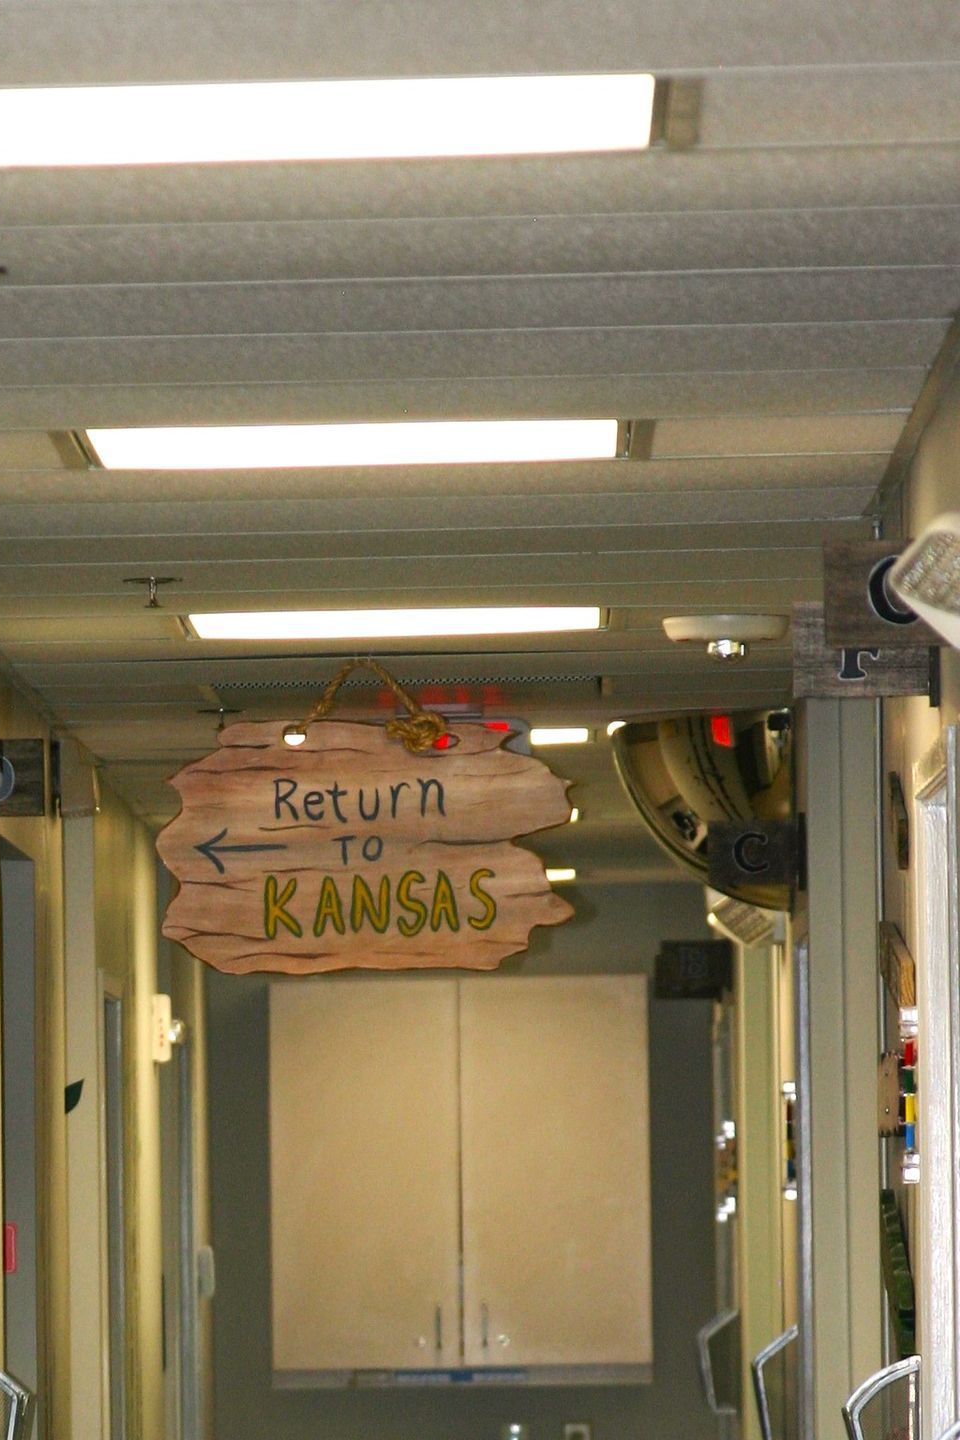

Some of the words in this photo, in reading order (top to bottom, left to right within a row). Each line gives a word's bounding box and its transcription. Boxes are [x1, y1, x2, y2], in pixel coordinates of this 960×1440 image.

[273, 777, 447, 821] Return
[731, 831, 770, 874] C
[263, 867, 497, 940] KANSAS
